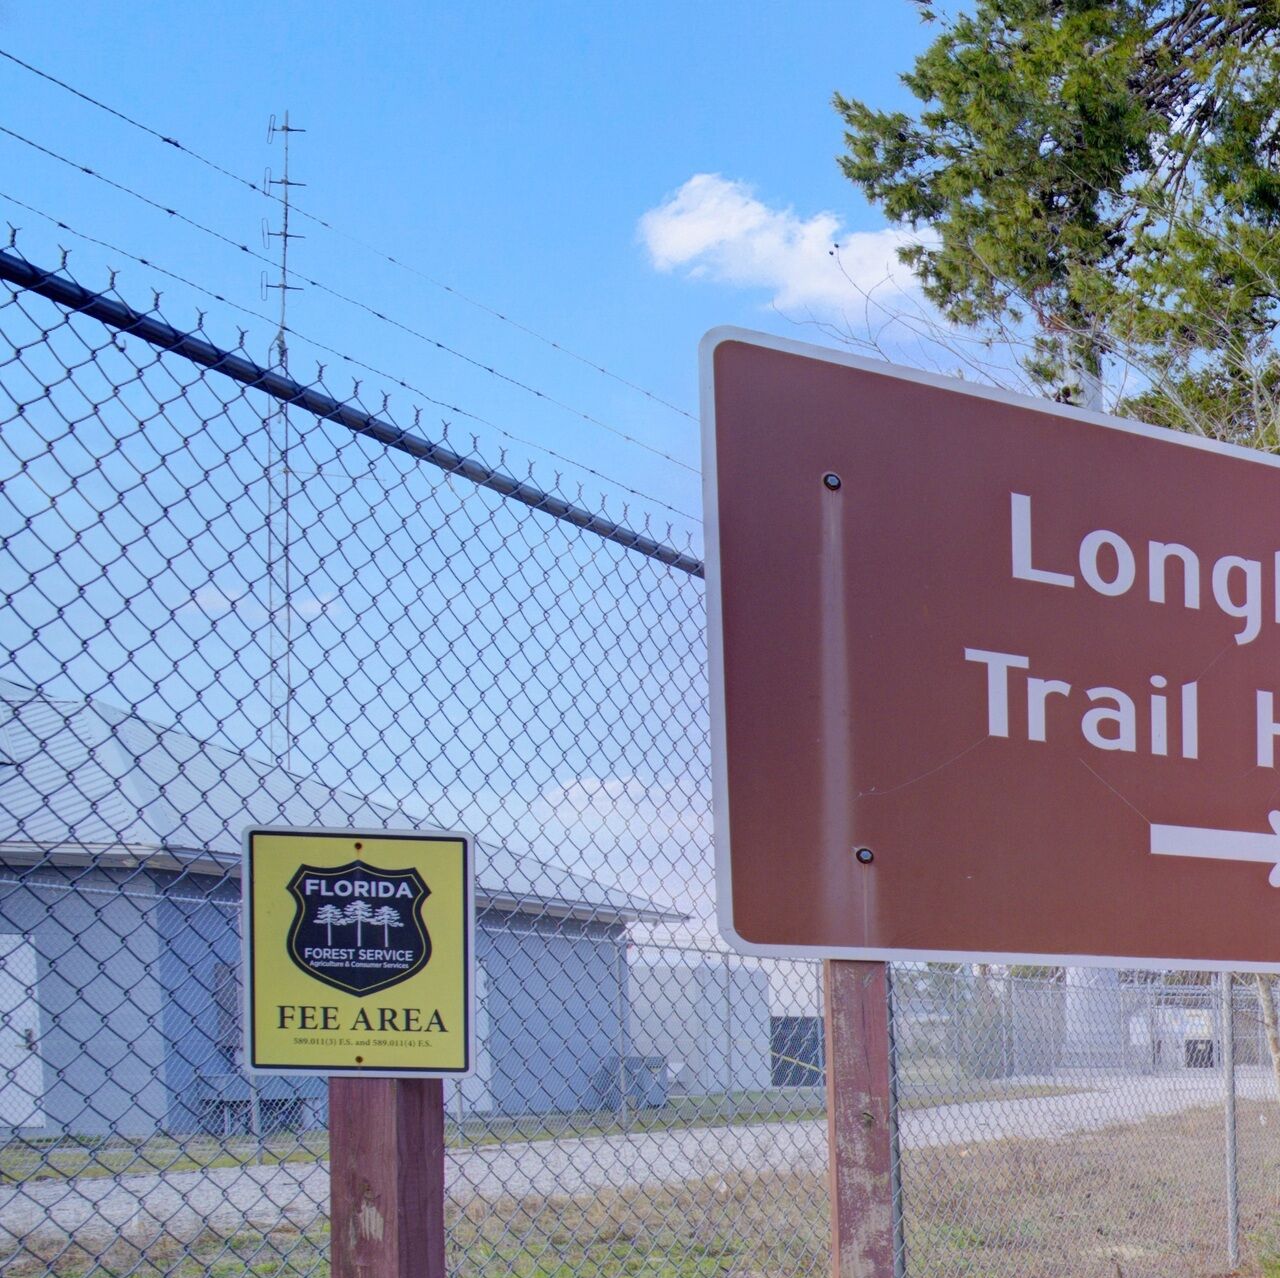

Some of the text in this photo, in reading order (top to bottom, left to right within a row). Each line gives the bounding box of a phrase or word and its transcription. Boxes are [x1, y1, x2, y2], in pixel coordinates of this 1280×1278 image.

[964, 647, 1198, 760] Trail
[305, 879, 413, 898] FLORIDA
[304, 948, 413, 961] FOREST SERVICE
[310, 960, 344, 968] Agriculture
[277, 1006, 448, 1032] FEE AREA
[339, 1038, 353, 1046] F.S.
